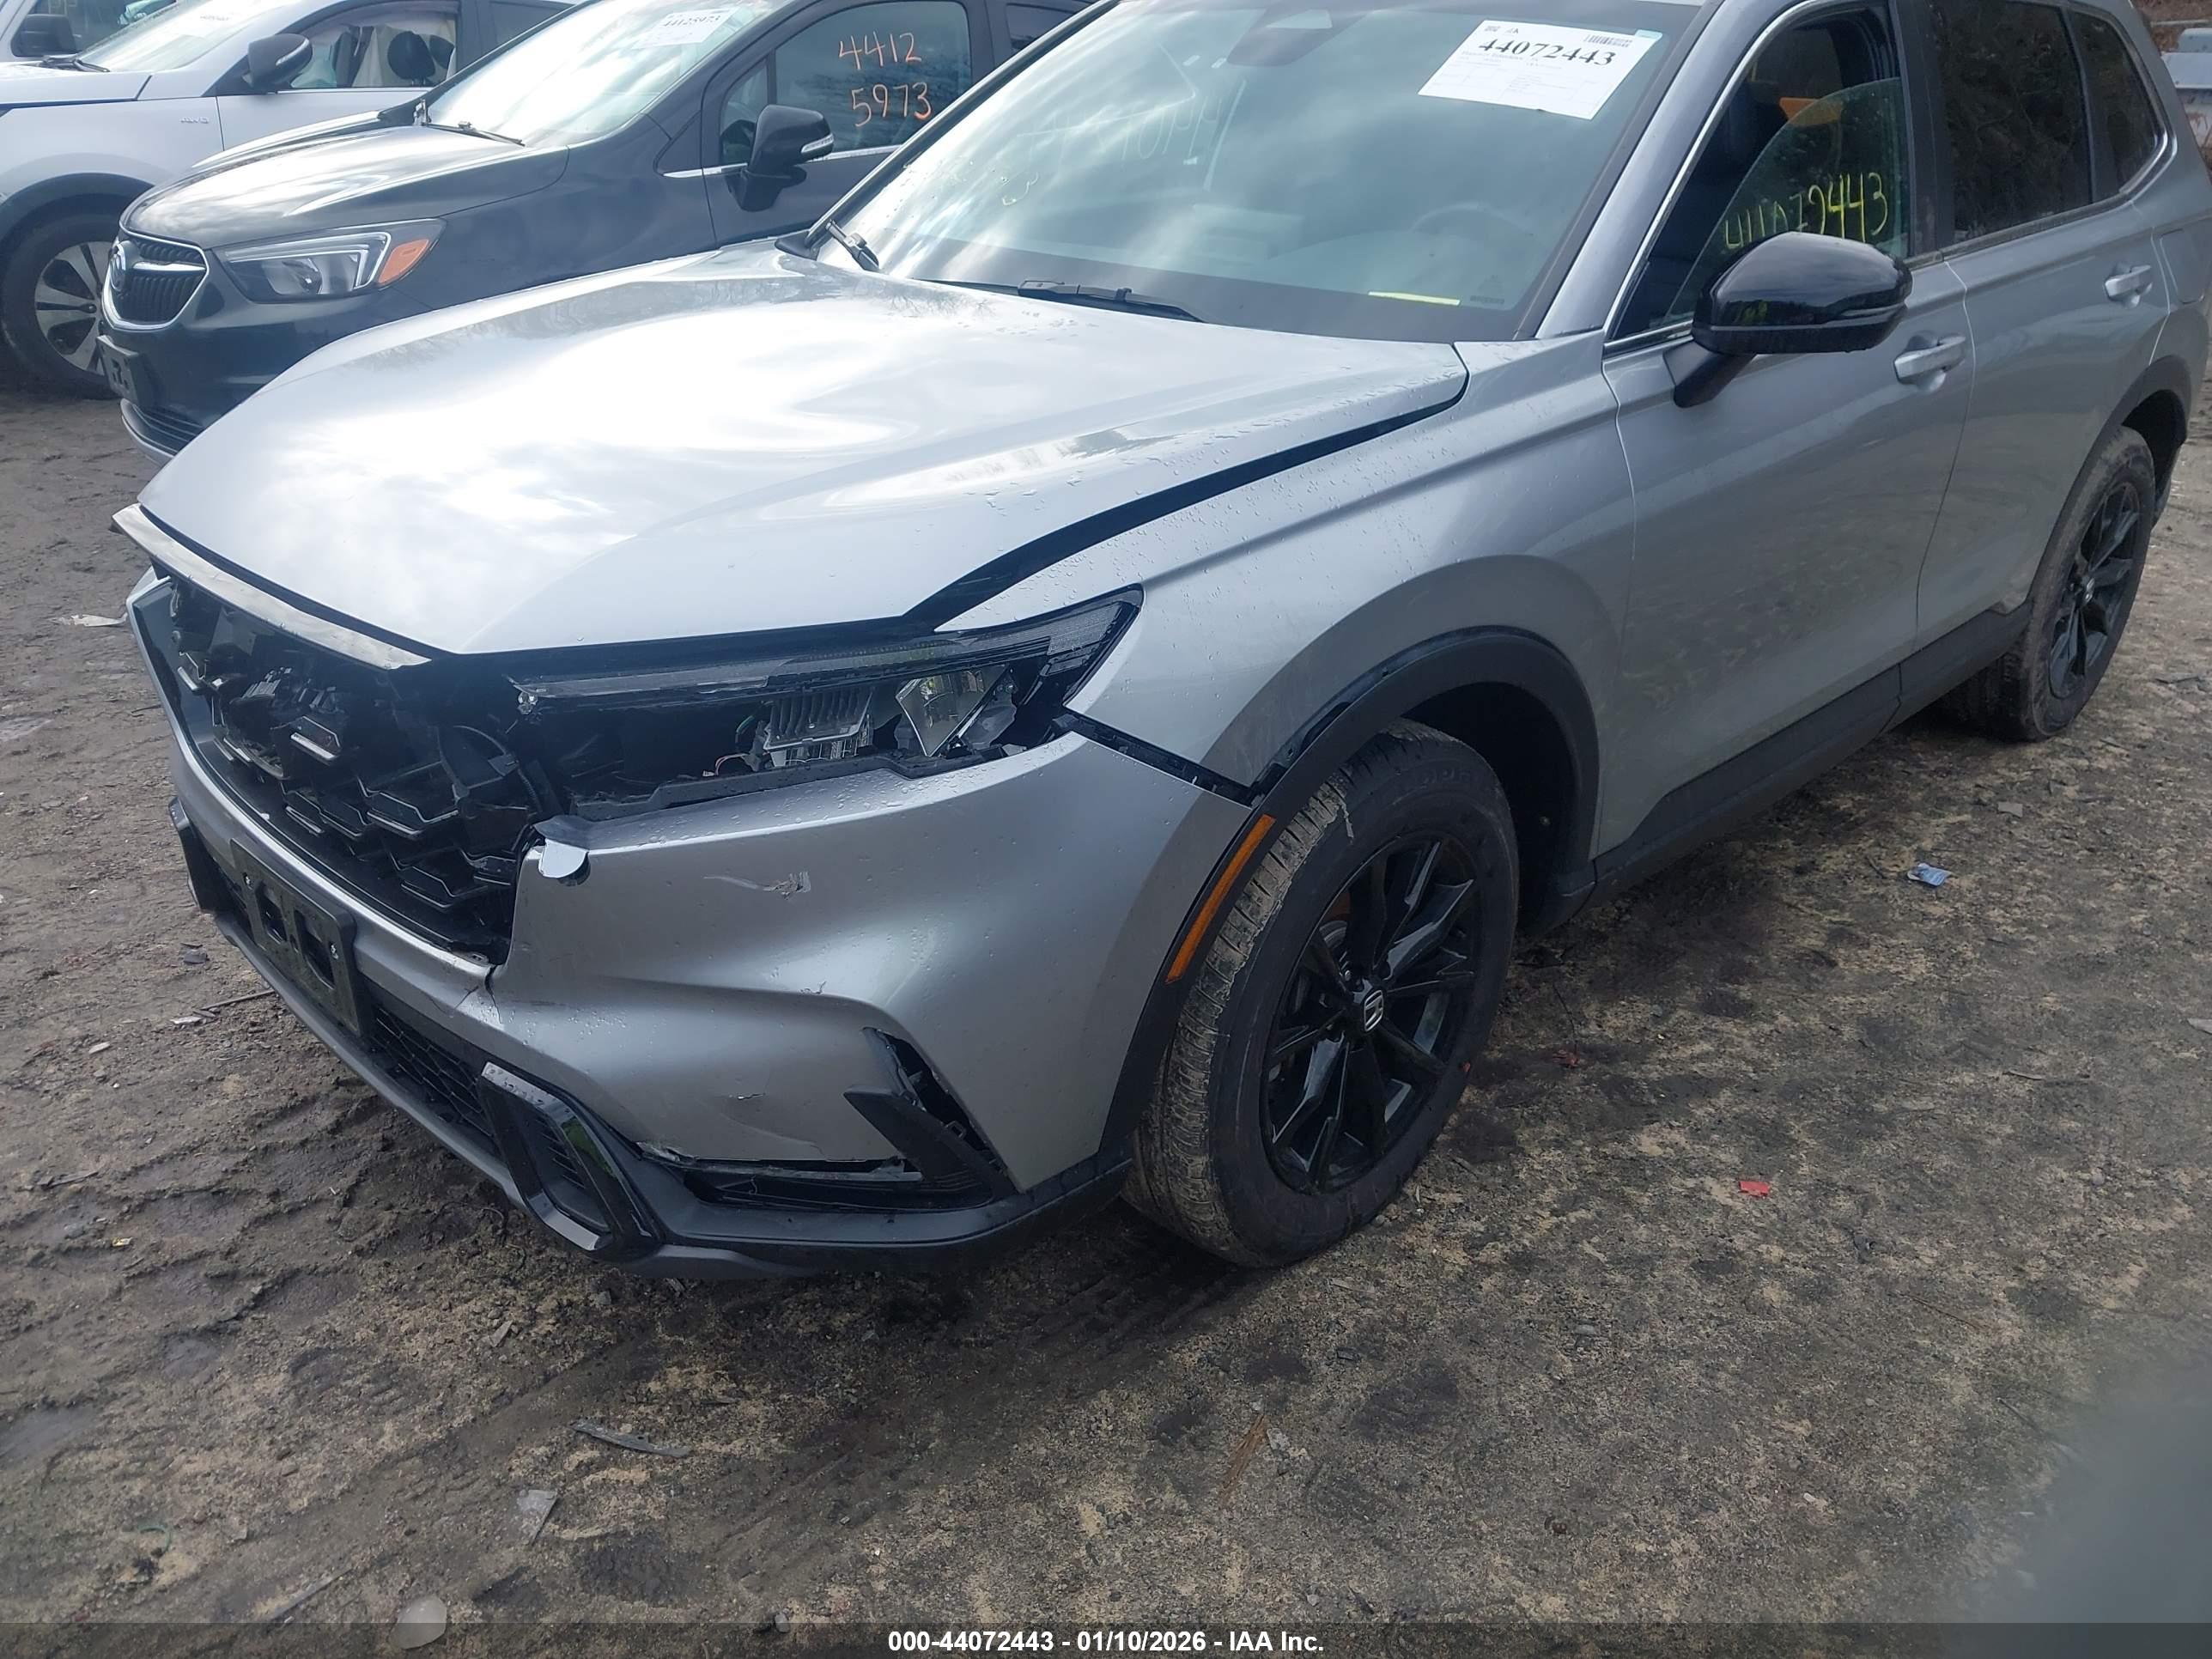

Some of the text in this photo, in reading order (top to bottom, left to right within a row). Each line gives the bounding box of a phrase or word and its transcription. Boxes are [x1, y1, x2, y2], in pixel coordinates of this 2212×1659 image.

[838, 31, 922, 70] 4412
[1478, 39, 1617, 66] 44072443
[851, 82, 932, 127] 5973
